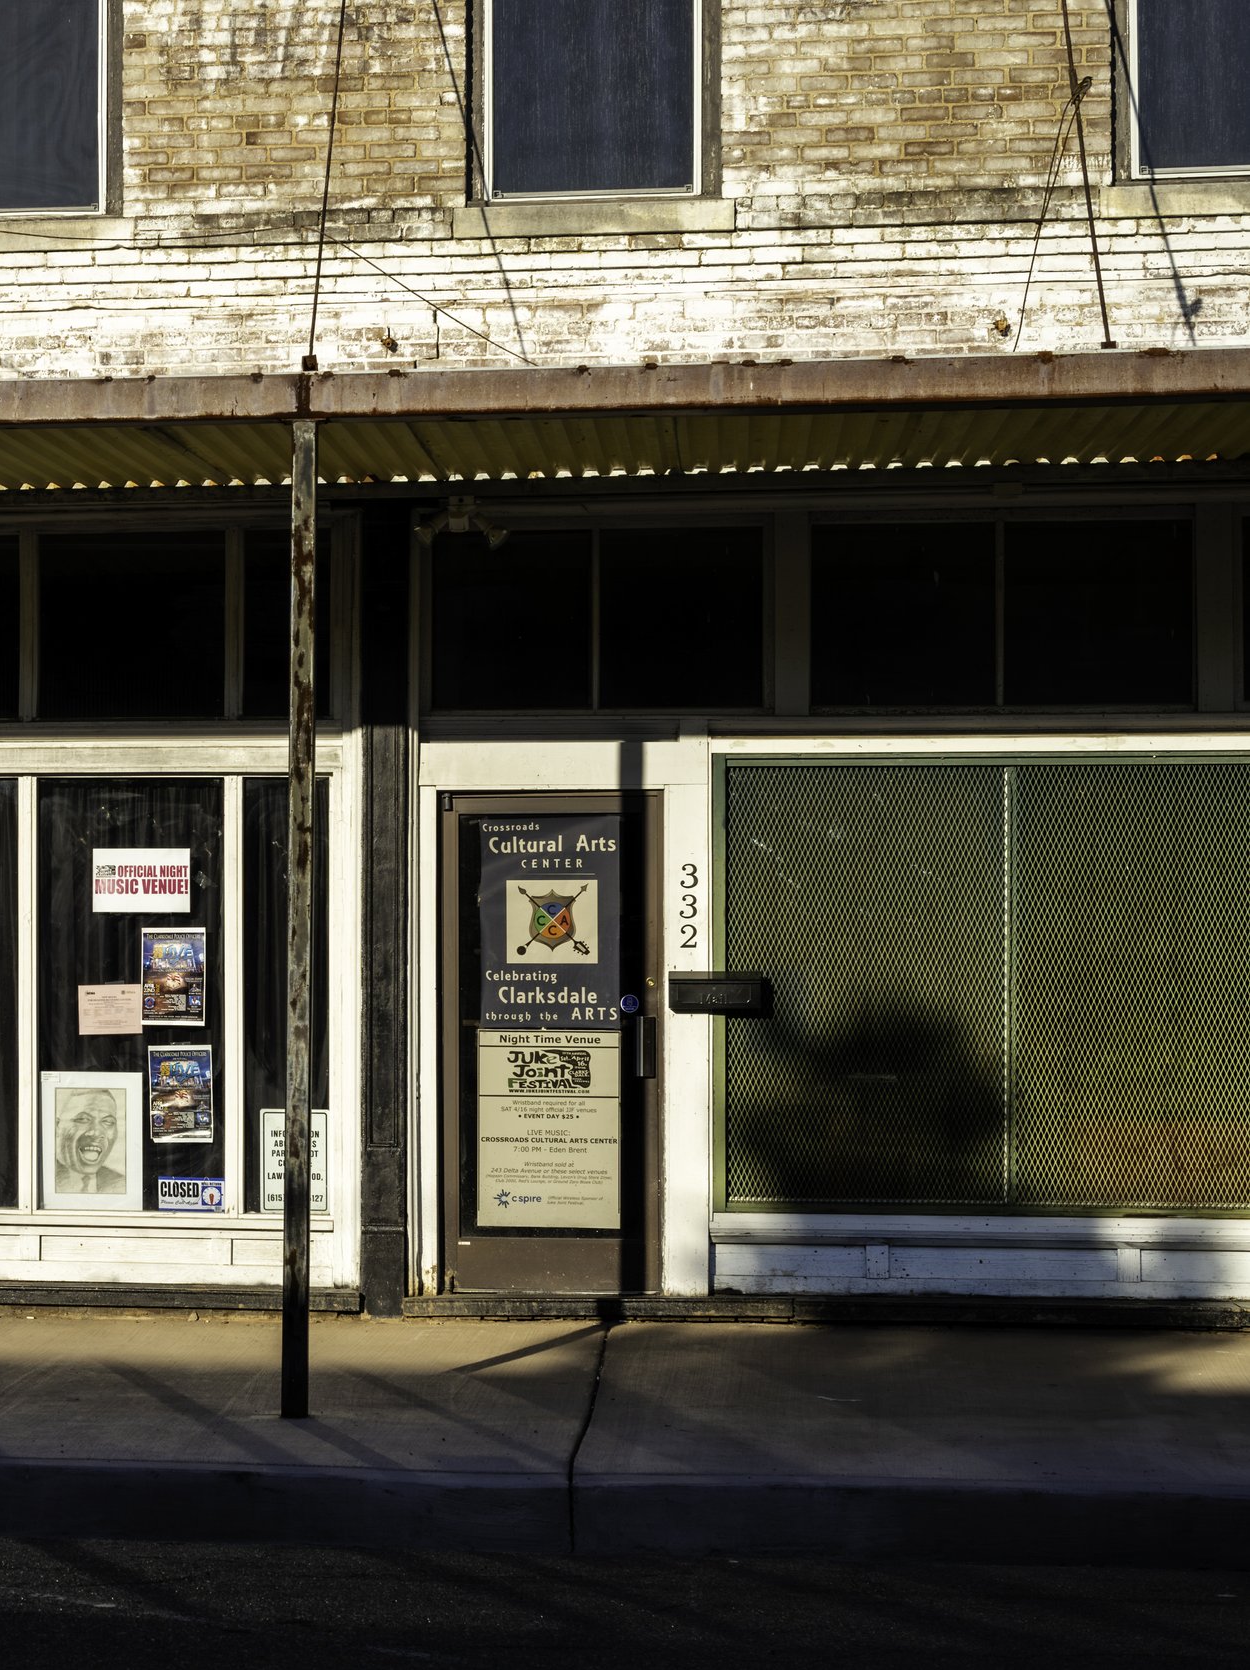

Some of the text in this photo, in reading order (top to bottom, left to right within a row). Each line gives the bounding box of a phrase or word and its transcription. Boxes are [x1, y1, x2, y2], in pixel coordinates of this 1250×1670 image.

[482, 822, 540, 832] Crossroads
[488, 834, 617, 854] Cultural Arts
[521, 858, 583, 869] CENTER
[117, 865, 158, 878] OFFICIAL
[159, 865, 189, 878] NIGHT
[94, 878, 189, 895] MUSIC VENUE!
[547, 904, 557, 915] C
[679, 863, 699, 949] 332
[560, 915, 569, 926] A
[547, 925, 557, 936] C
[485, 970, 557, 984] Celebrating
[498, 986, 598, 1004] Clarksdale
[485, 1011, 531, 1022] through
[539, 1011, 559, 1021] the
[571, 1007, 618, 1021] ARTS
[499, 1034, 601, 1045] Night Time Venue
[160, 1181, 200, 1198] CLOSED
